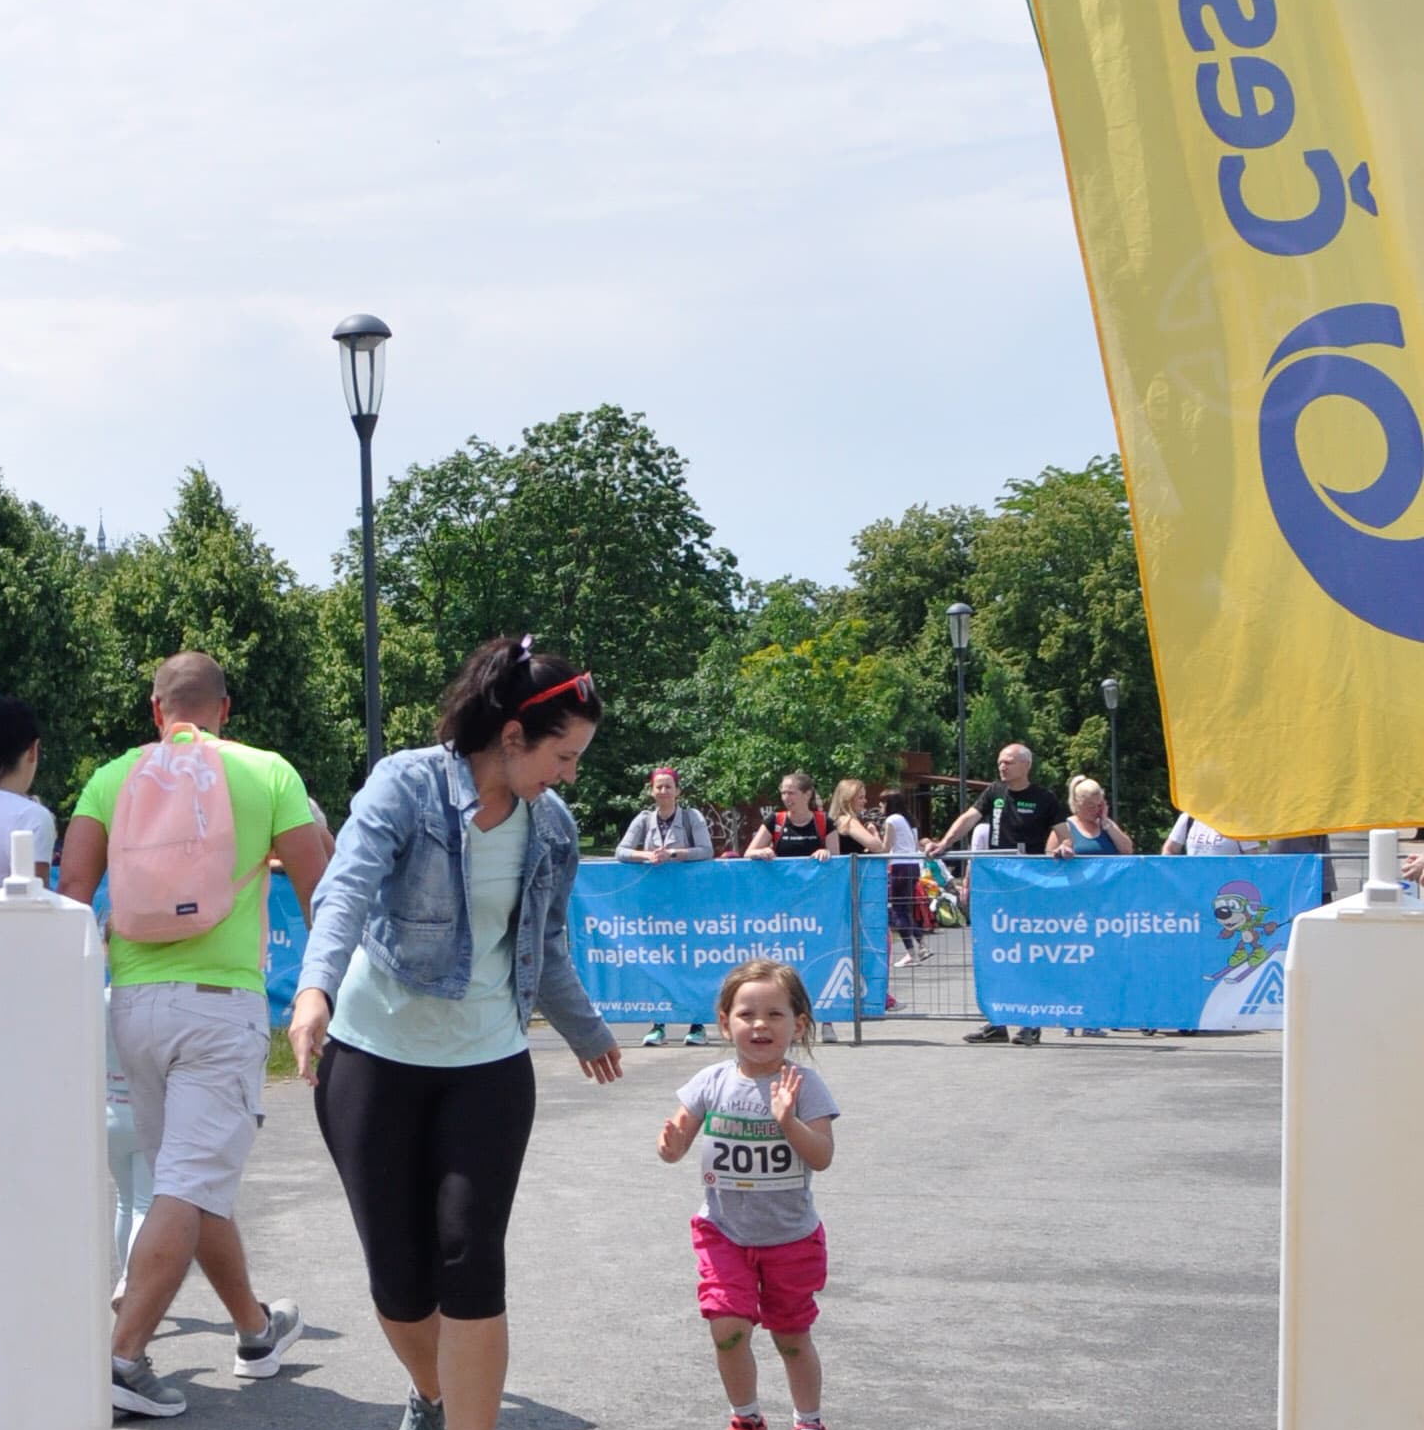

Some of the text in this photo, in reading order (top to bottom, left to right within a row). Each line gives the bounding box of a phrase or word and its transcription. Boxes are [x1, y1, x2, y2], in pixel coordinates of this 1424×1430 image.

[585, 912, 824, 939] Pojistíme vaši rodinu,
[991, 908, 1201, 938] Úrazové pojištění
[587, 941, 805, 968] majetek i podnikání
[992, 943, 1096, 964] od PVZP
[591, 1000, 673, 1013] www.pvzp.cz
[992, 1001, 1084, 1016] www.pvzp.cz
[712, 1141, 793, 1174] 2019
